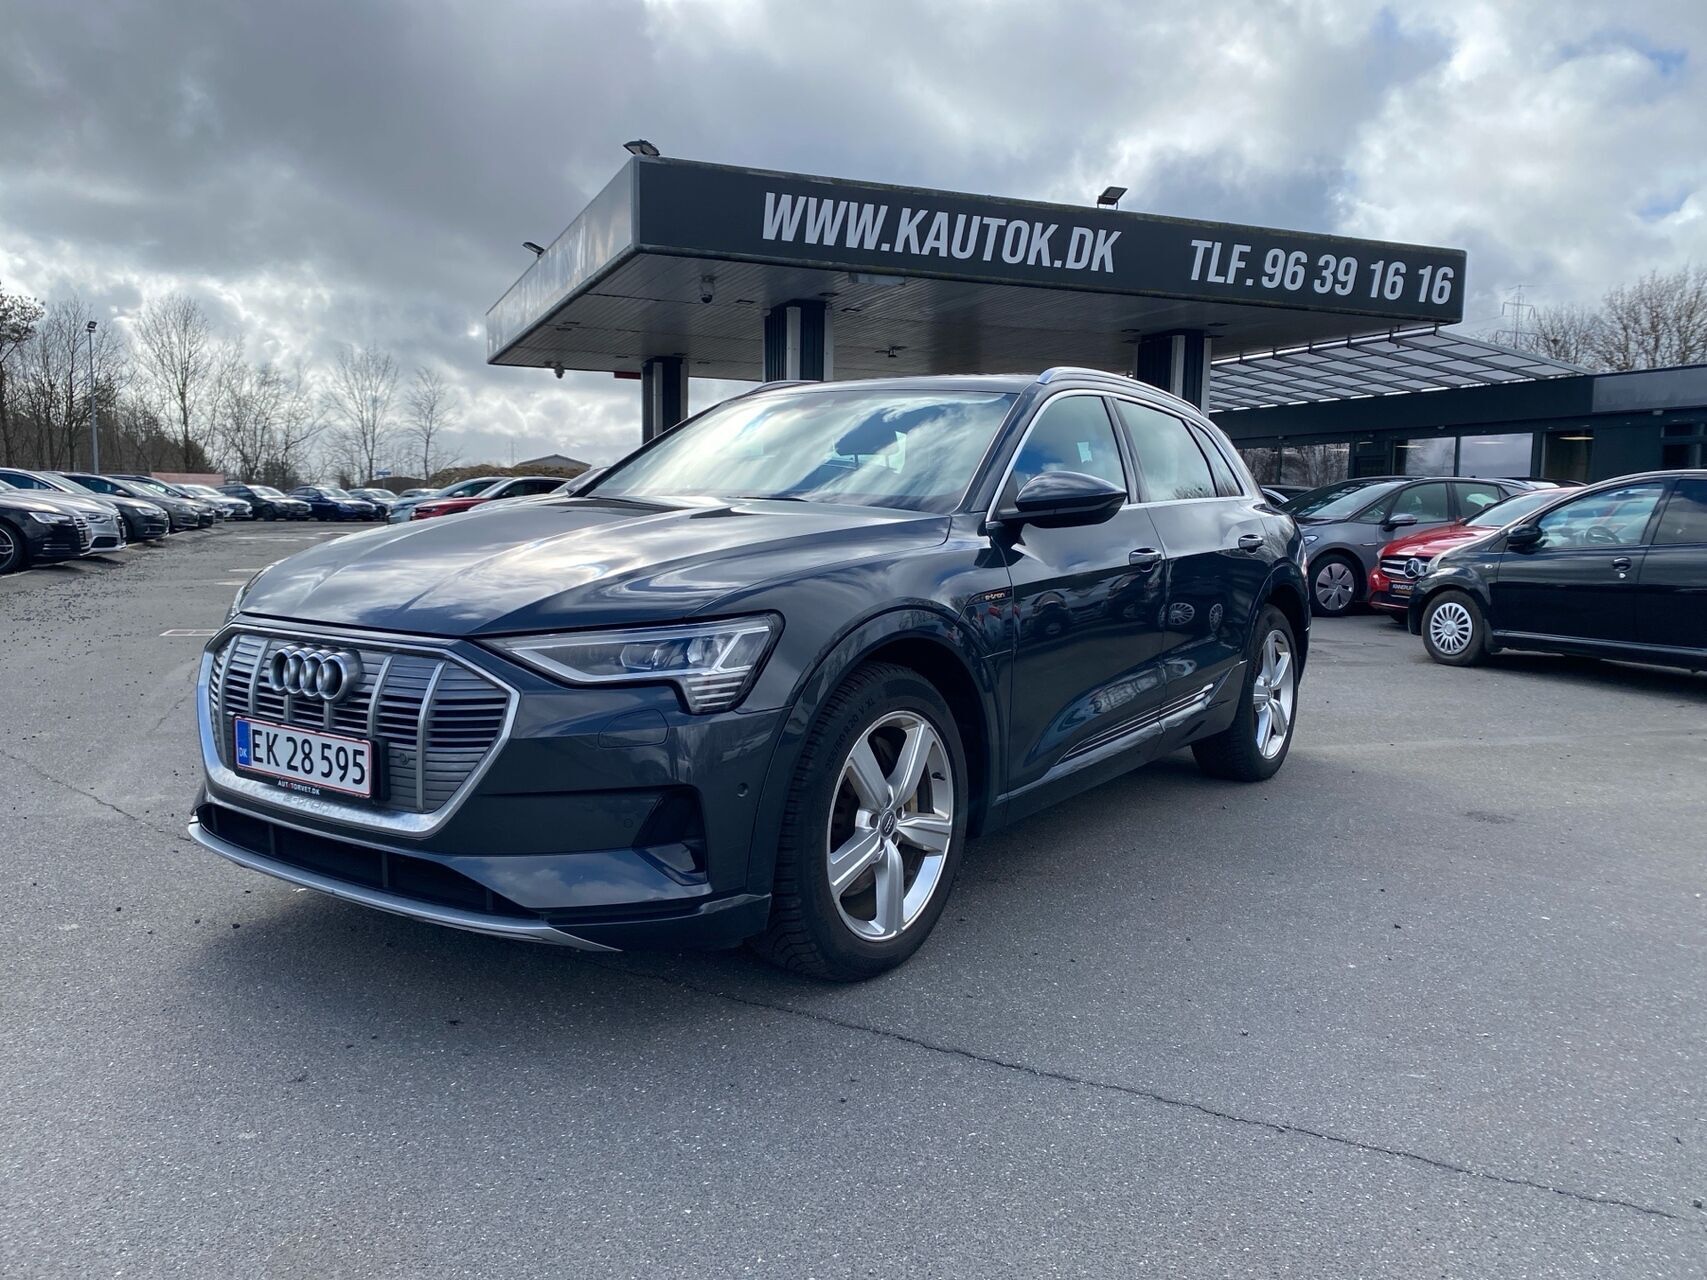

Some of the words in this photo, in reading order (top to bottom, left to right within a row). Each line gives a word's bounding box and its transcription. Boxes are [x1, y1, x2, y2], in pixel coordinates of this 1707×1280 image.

[762, 192, 1122, 273] WWW.KAUTOK.DK
[1190, 239, 1254, 286] TLF.
[1261, 248, 1308, 291] 96
[1313, 254, 1358, 296] 39
[1369, 260, 1407, 300] 16
[1418, 265, 1455, 305] 16
[984, 592, 1006, 601] e-tron
[251, 729, 280, 767] EK
[286, 736, 314, 775] 28
[320, 742, 366, 785] 595
